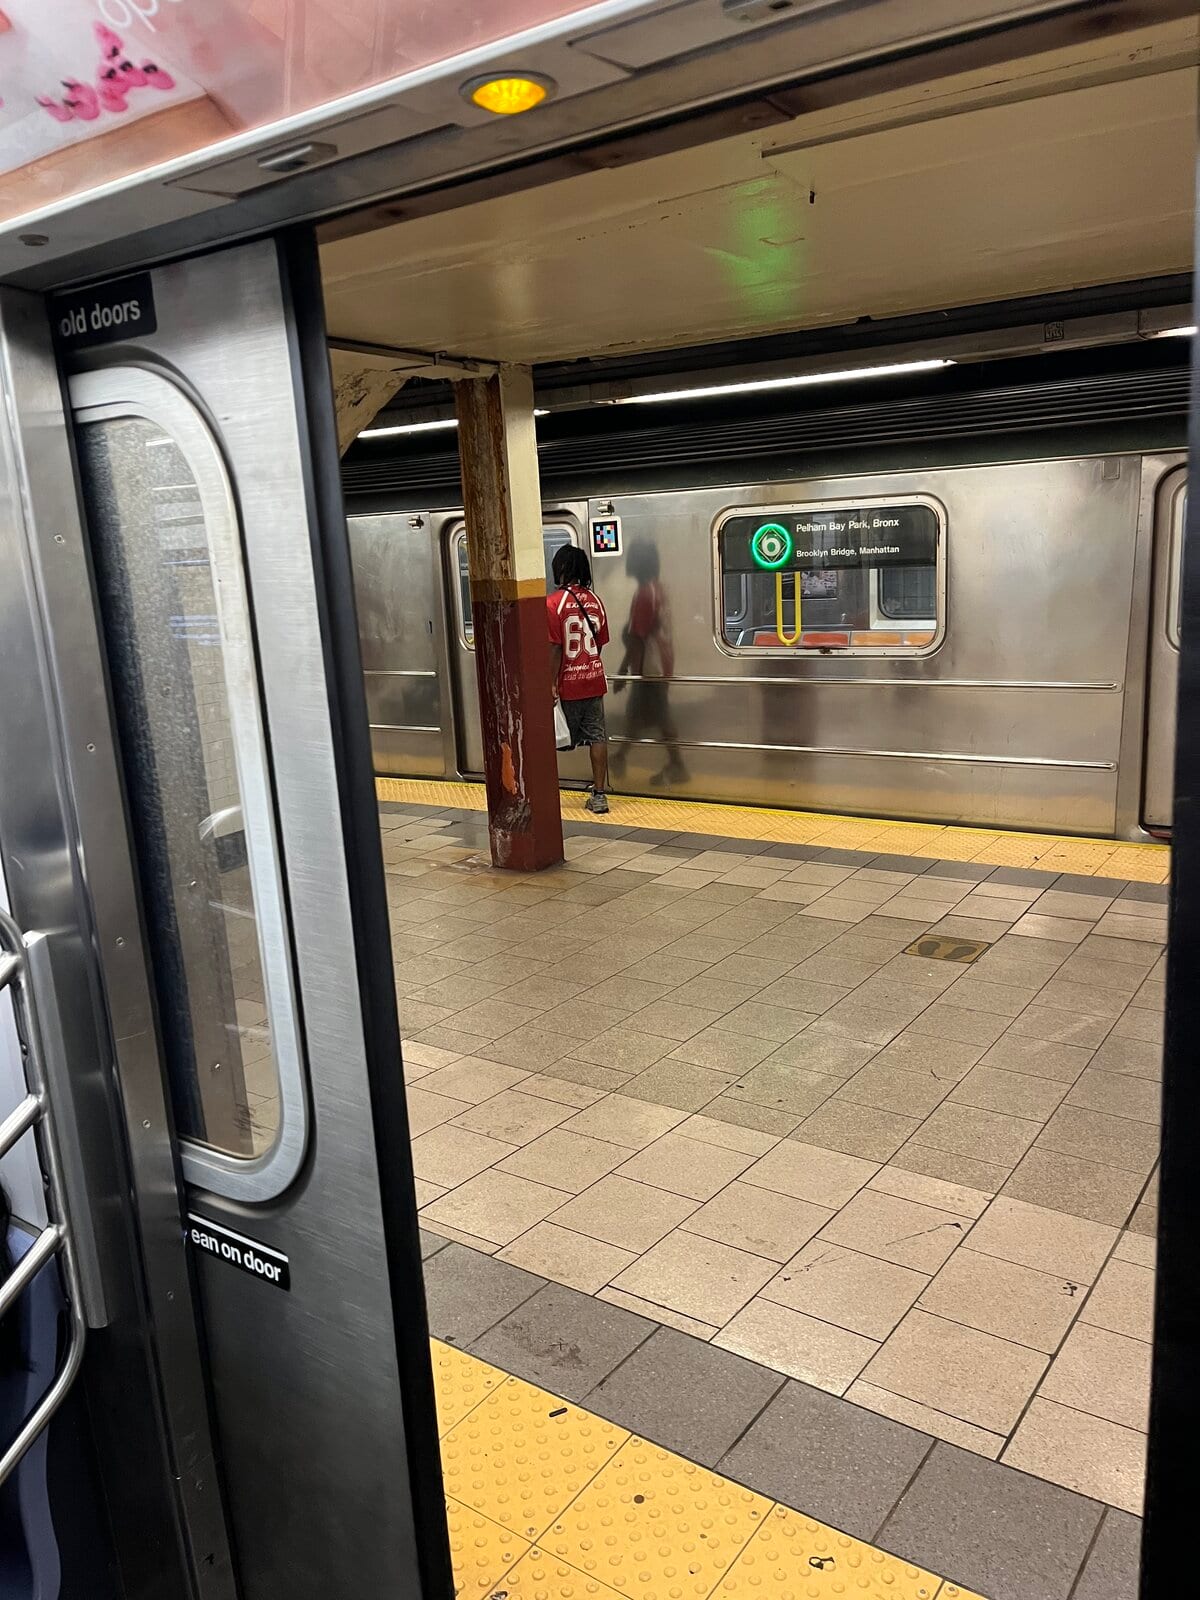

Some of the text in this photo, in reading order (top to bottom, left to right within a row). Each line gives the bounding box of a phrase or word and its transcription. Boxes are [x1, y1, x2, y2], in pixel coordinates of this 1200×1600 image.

[91, 300, 141, 330] doors
[796, 519, 900, 533] Pelham Bay Park, Bronx
[761, 532, 782, 557] 6
[796, 546, 900, 558] Brooklyn Bridge, Manhattan
[191, 1229, 282, 1282] ean on door
